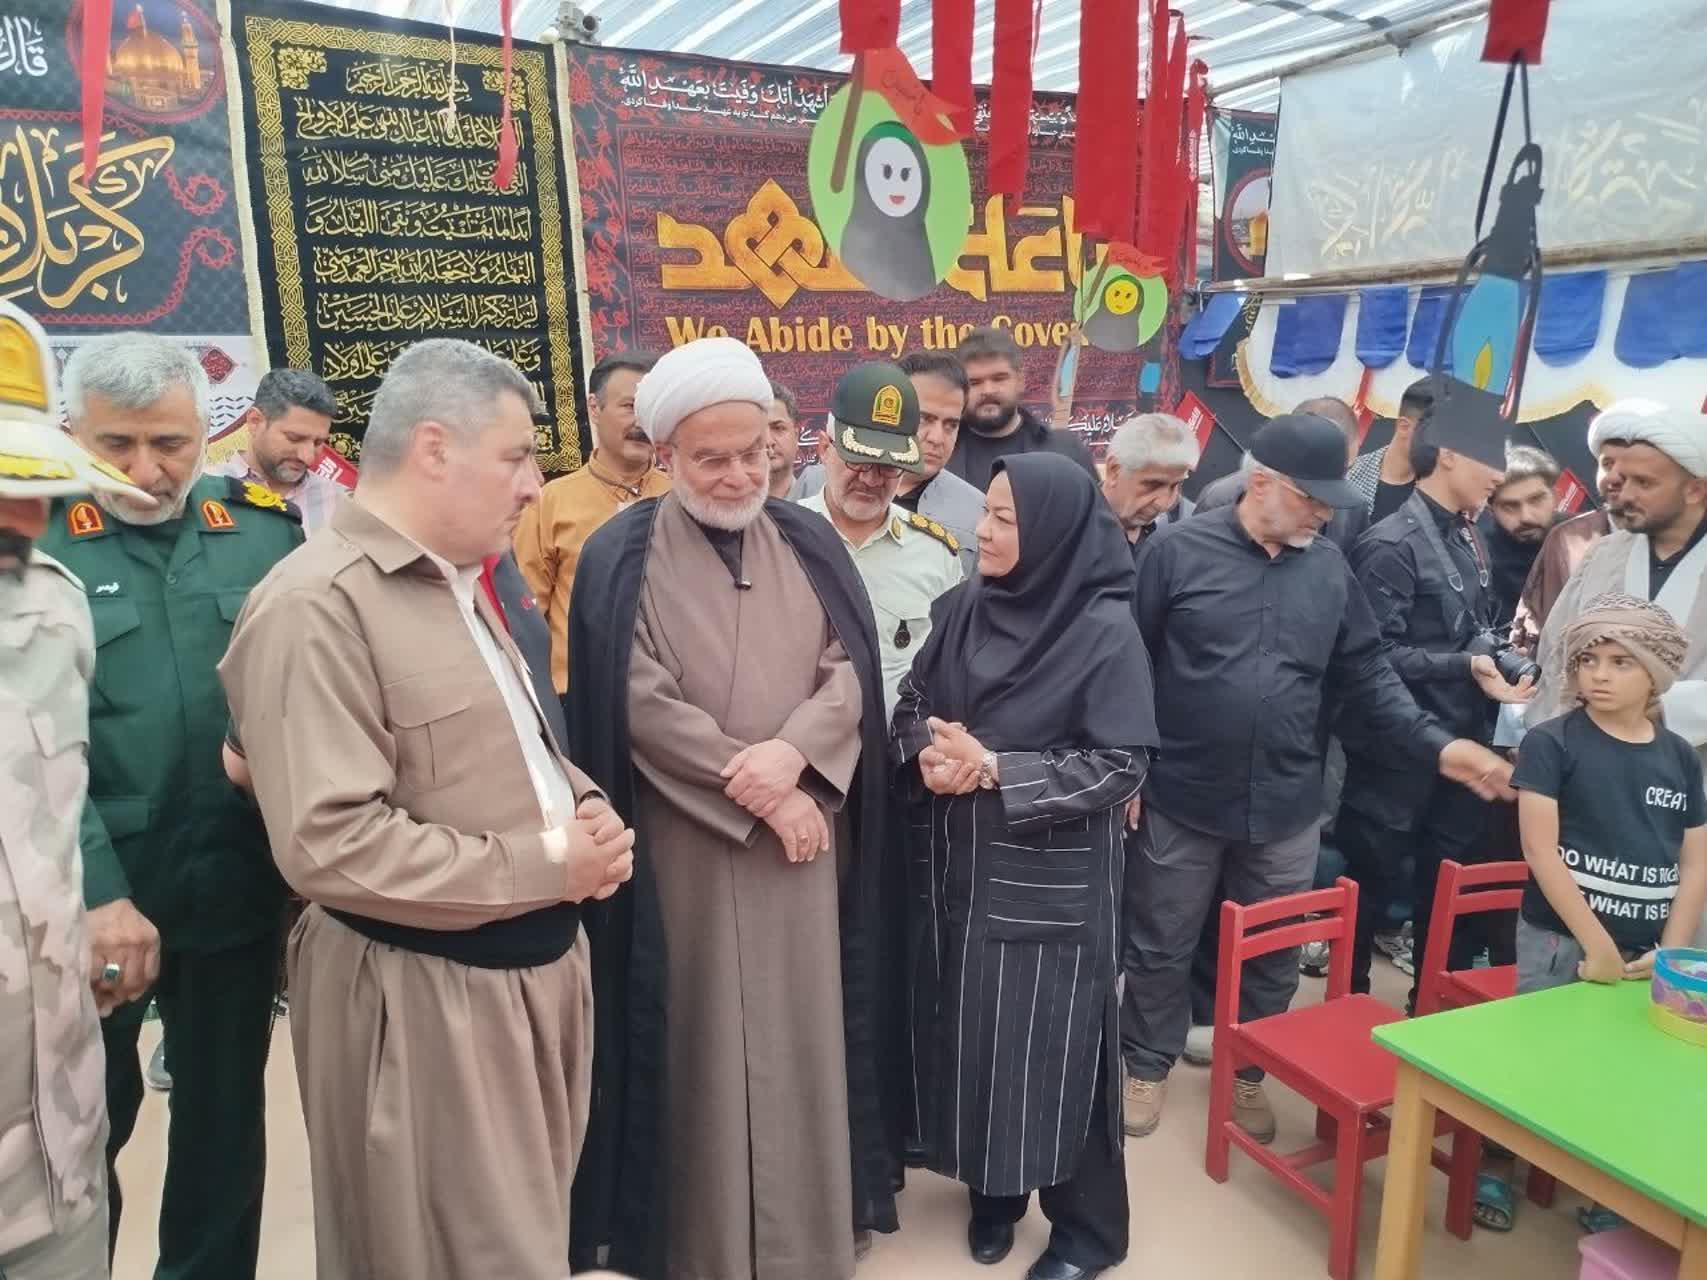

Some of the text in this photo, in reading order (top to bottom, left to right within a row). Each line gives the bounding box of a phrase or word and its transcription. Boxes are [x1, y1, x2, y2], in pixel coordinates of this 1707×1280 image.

[746, 315, 853, 351] Abide
[868, 313, 908, 359] by
[1584, 854, 1639, 881] WHAT
[1642, 866, 1657, 883] IS
[1588, 894, 1642, 919] WHAT
[1645, 904, 1659, 921] IS
